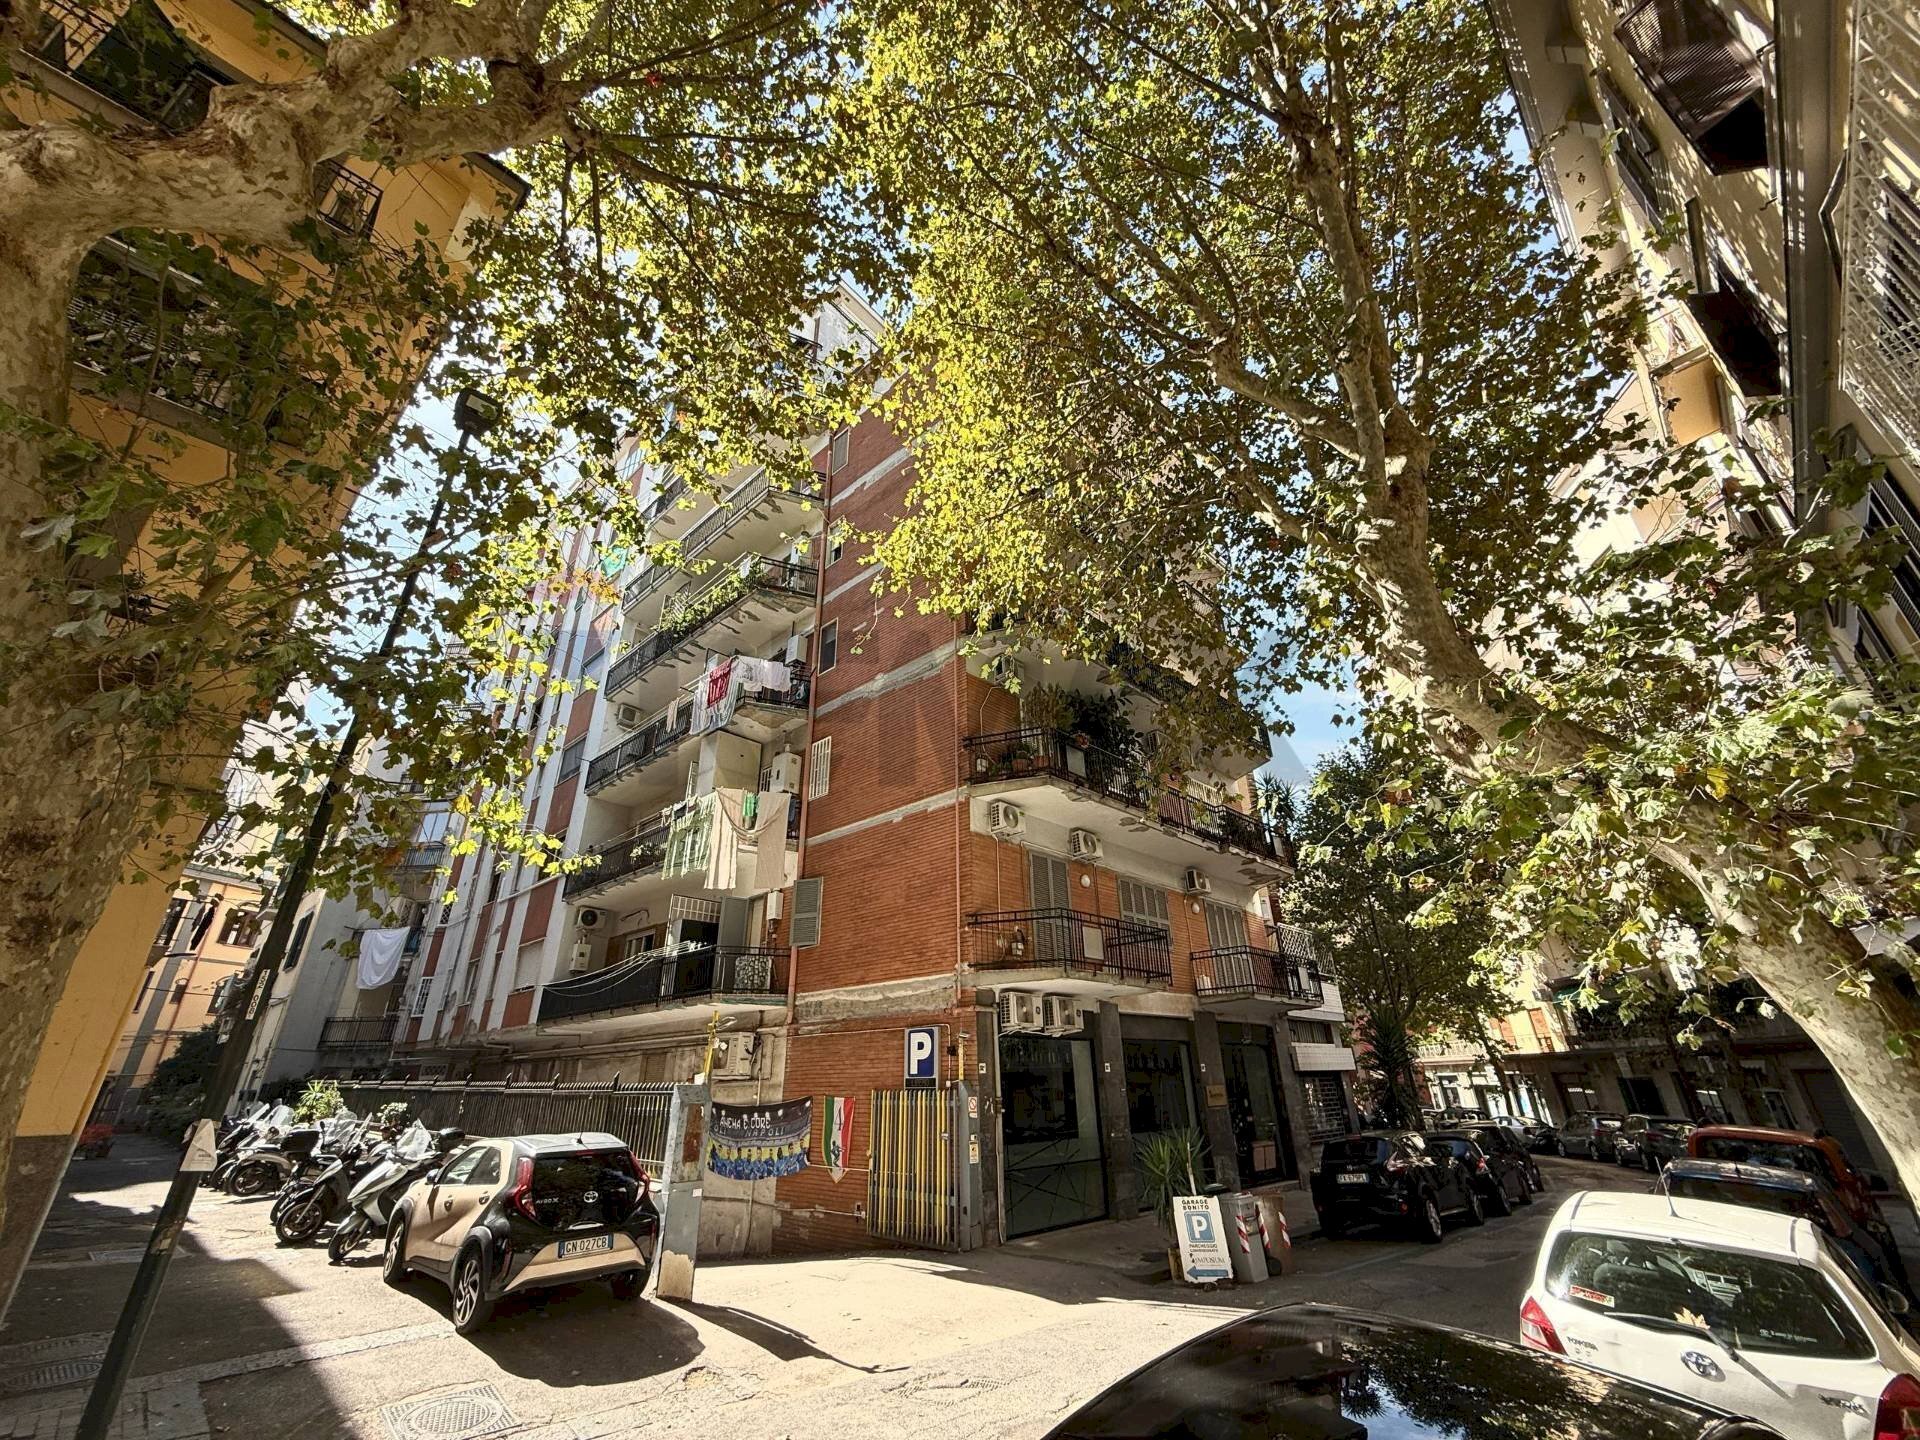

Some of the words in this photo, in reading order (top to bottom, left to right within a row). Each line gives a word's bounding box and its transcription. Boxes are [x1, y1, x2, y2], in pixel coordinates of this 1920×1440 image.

[910, 1032, 932, 1075] P
[744, 1126, 784, 1137] NAPOLI
[750, 1117, 771, 1129] CORE
[1191, 1215, 1208, 1239] P
[566, 1240, 578, 1253] GN
[579, 1236, 607, 1251] 027CB
